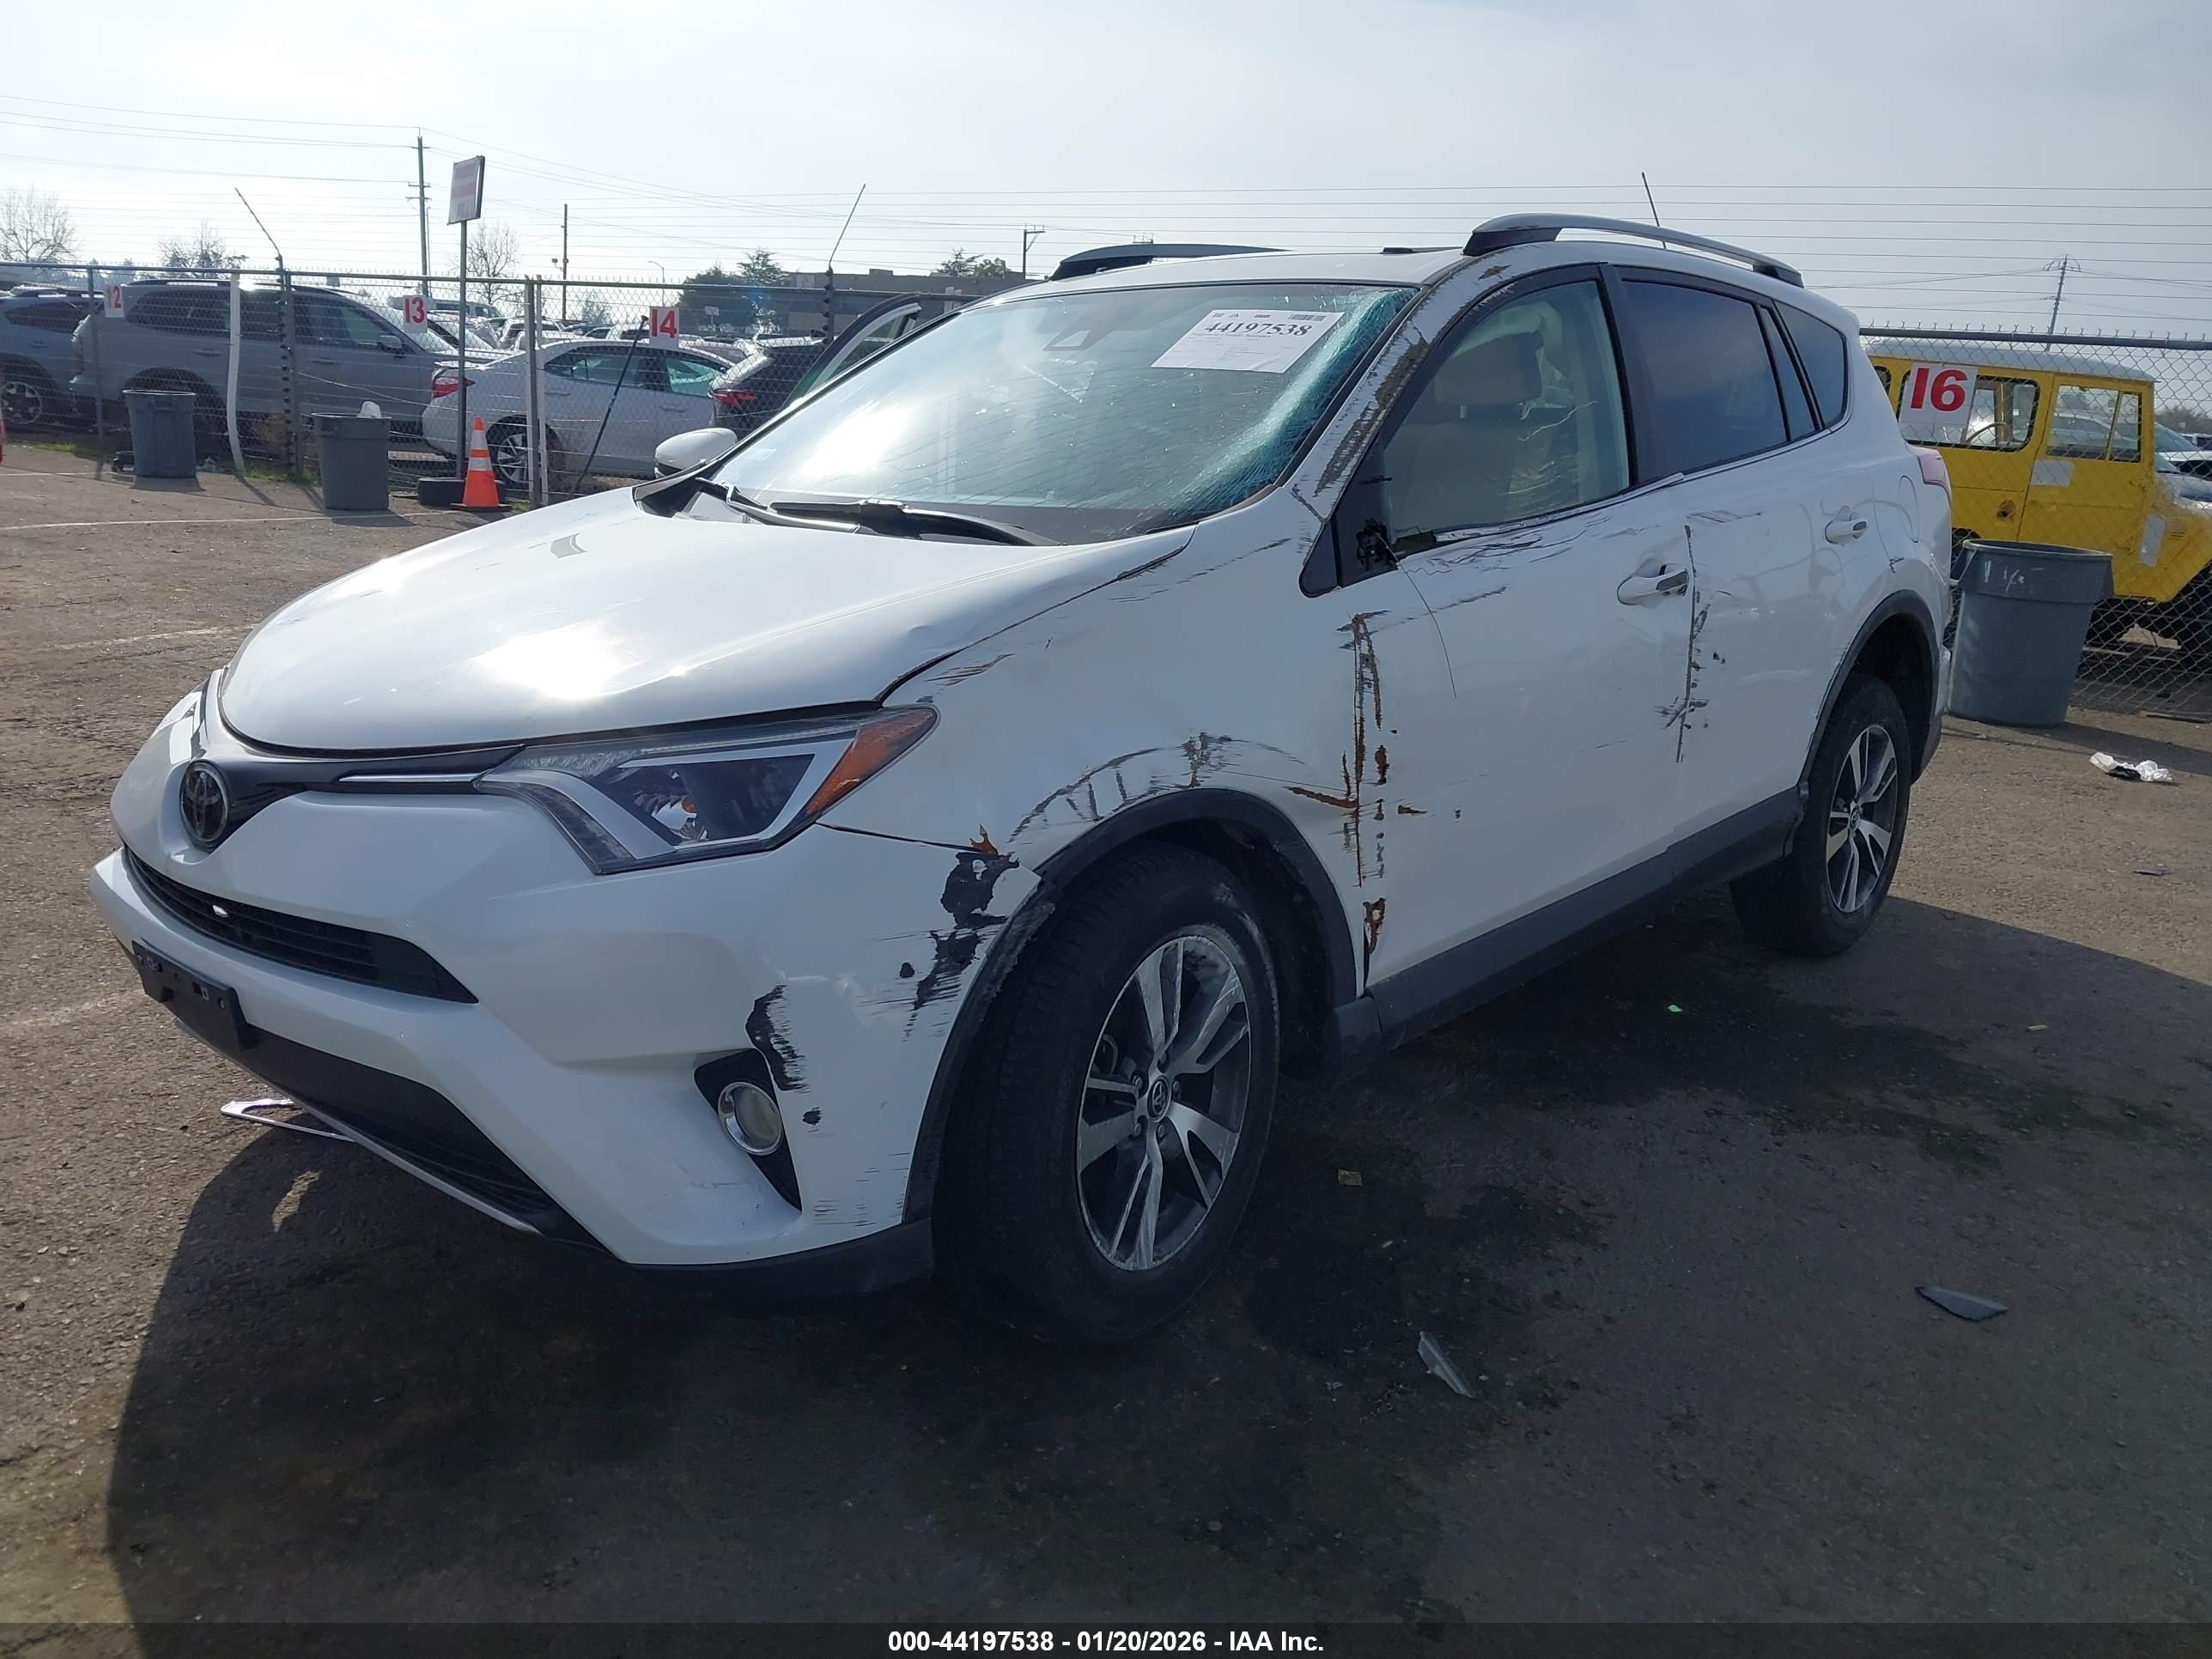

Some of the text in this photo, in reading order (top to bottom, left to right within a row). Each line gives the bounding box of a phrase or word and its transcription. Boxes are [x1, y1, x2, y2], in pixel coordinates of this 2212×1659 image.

[404, 296, 425, 324] 13
[651, 308, 678, 338] 14
[1204, 321, 1313, 337] 44197538
[1910, 368, 1968, 412] 16
